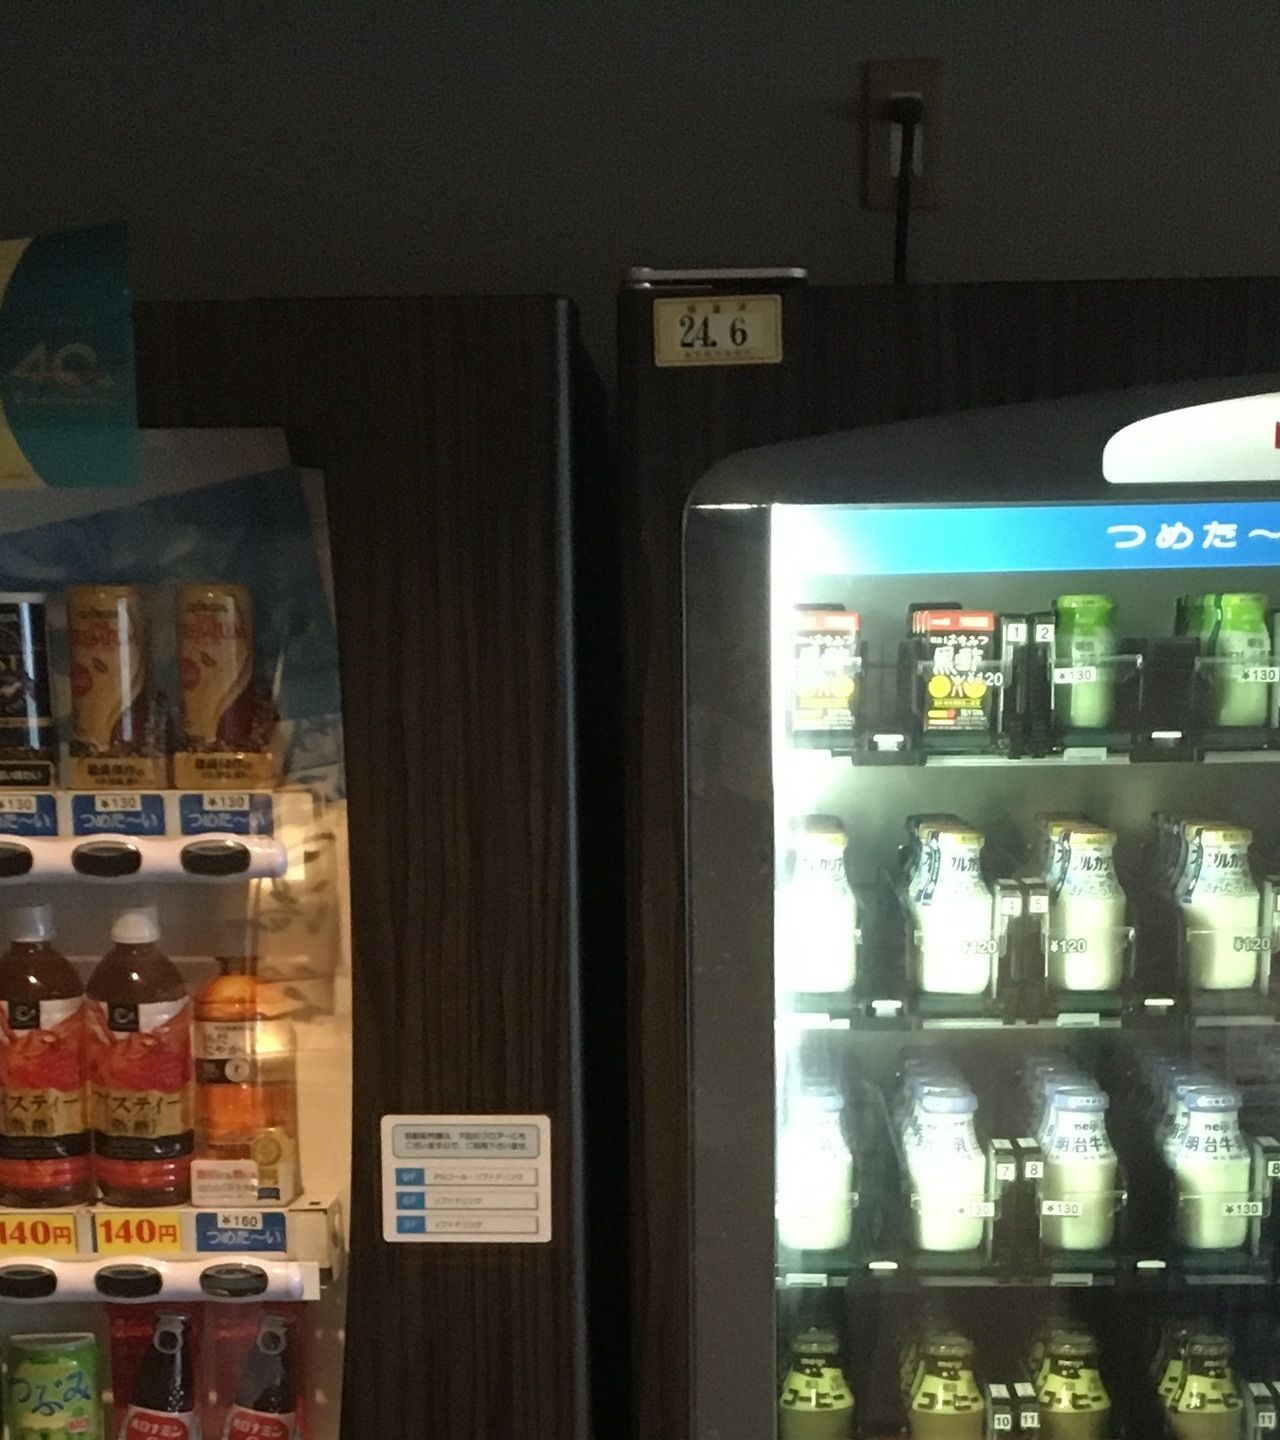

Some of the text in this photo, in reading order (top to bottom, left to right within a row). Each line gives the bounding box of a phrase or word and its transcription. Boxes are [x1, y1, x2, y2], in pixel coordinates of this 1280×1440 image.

[1040, 626, 1050, 640] 2
[1029, 1164, 1039, 1175] 8
[1271, 1162, 1280, 1175] 8
[1225, 1203, 1259, 1215] ¥130
[99, 1218, 178, 1245] 140円
